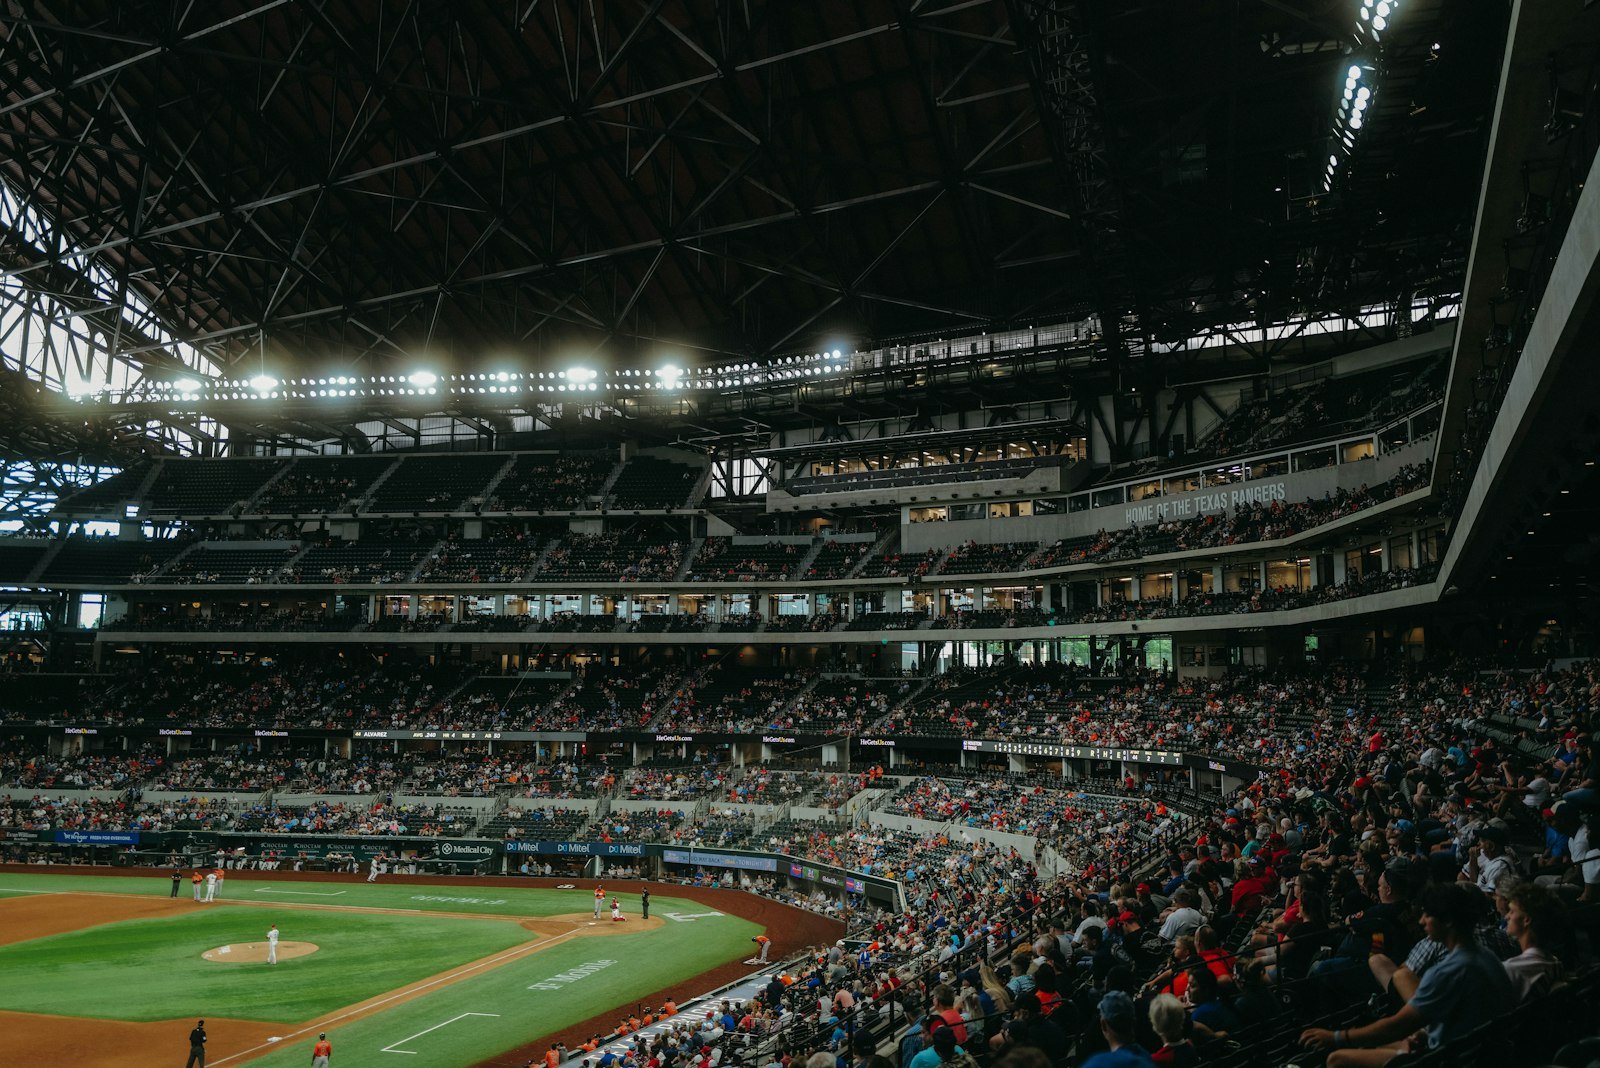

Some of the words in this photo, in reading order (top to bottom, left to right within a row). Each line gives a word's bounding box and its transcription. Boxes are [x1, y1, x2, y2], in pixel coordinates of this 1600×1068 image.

[1125, 506, 1154, 524] HOME
[1156, 504, 1168, 519] OF
[1171, 498, 1192, 516] THE
[1194, 492, 1228, 513] TEXAS
[1231, 482, 1286, 506] RANGERS
[70, 832, 88, 843] Kroger
[480, 846, 494, 856] City
[517, 843, 539, 852] Mitel
[568, 844, 590, 853] Mitel
[620, 844, 642, 854] Mitel
